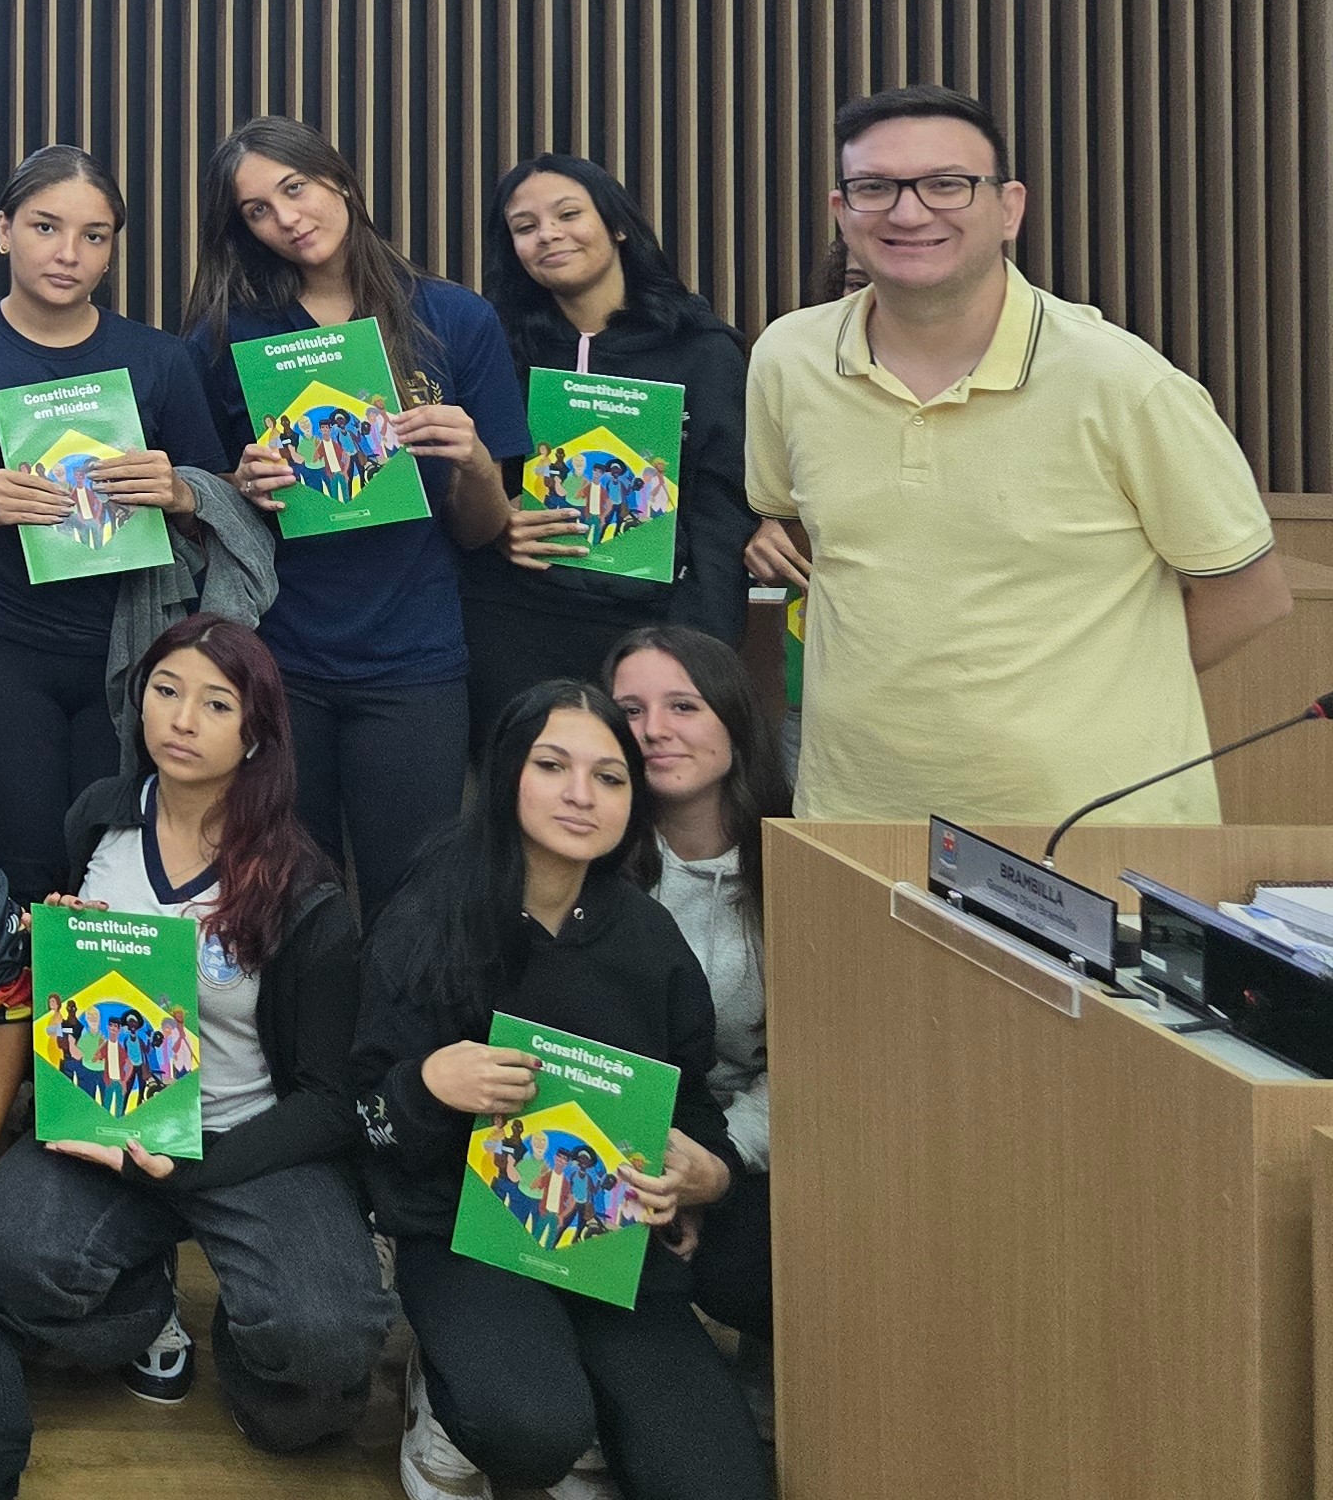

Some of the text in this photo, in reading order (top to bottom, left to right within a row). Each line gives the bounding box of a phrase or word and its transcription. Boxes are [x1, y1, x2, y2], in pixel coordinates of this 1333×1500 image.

[264, 333, 345, 357] Constituição
[275, 351, 342, 371] em Miúdos
[24, 382, 101, 406] Constituição
[563, 379, 648, 402] Constituição
[33, 399, 99, 420] em Miúdos
[569, 399, 640, 416] em Miúdos
[1000, 862, 1065, 908] BRAMBILLA
[68, 916, 158, 939] Constituição
[76, 939, 152, 956] em Miúdos
[531, 1034, 634, 1078] Constituição
[564, 1064, 622, 1095] Miúdos
